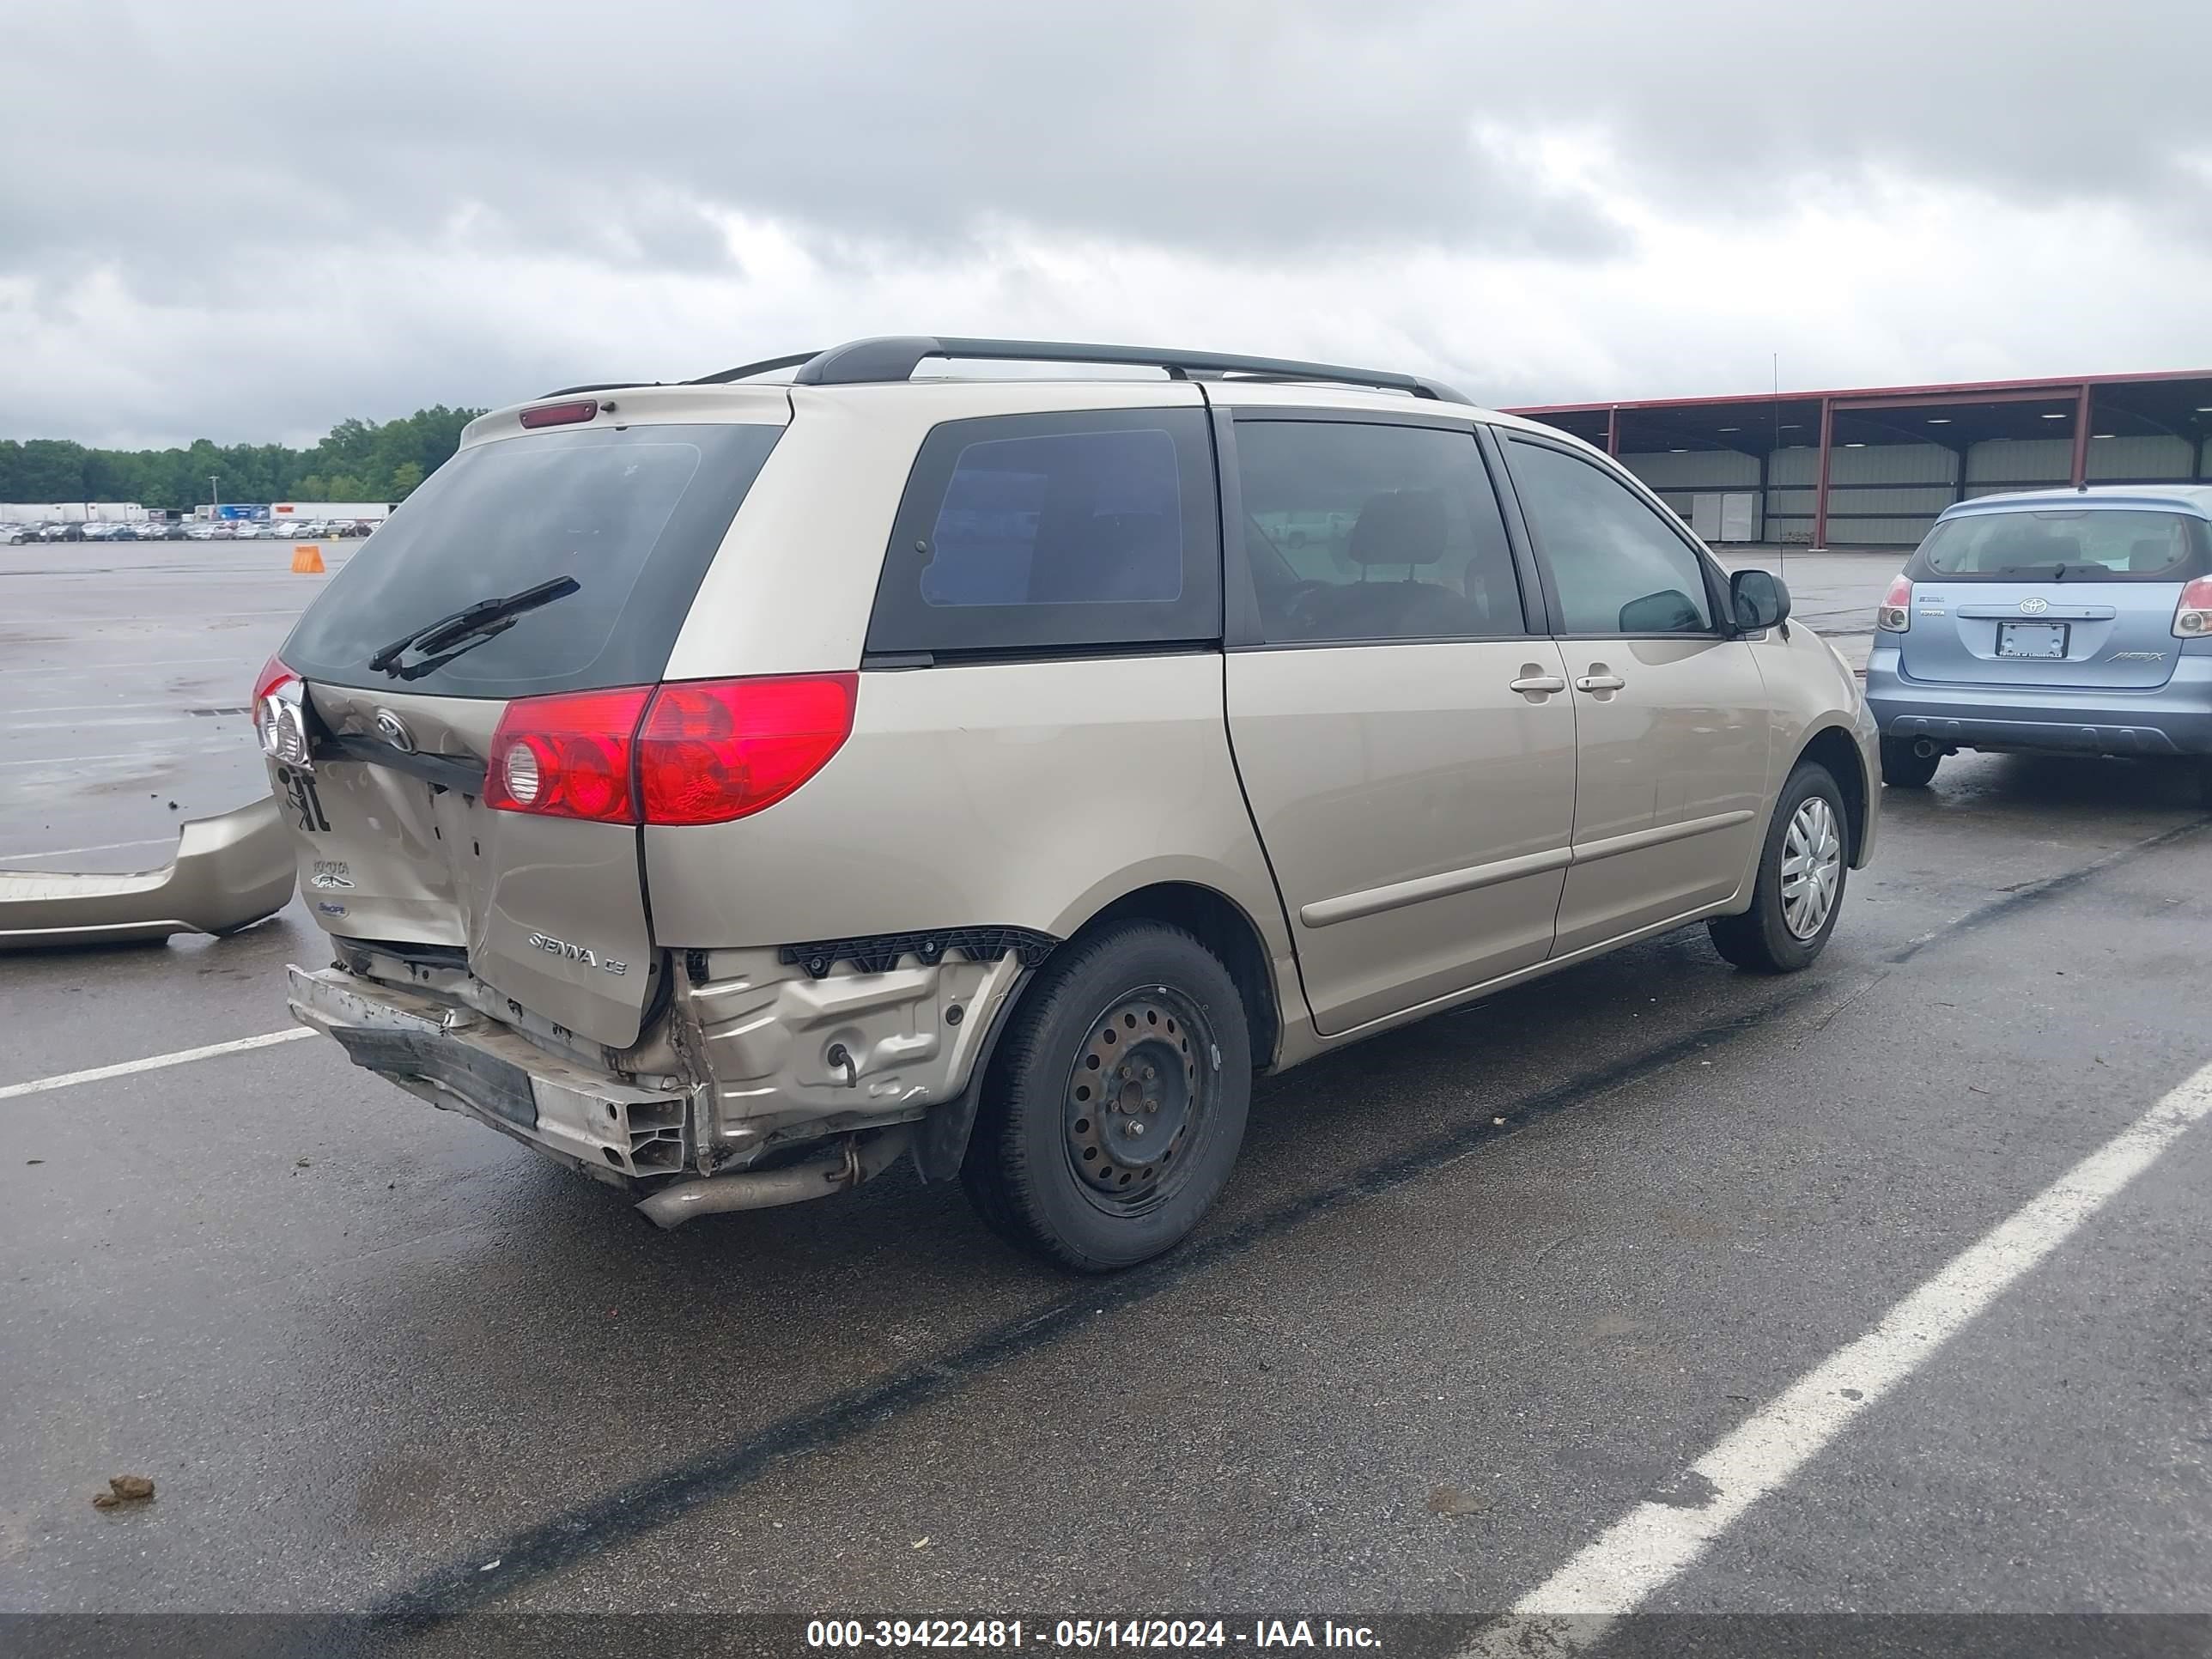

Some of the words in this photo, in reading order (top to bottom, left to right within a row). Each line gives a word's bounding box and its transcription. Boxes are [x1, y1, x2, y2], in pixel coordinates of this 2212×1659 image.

[2105, 652, 2167, 663] MATRIX
[313, 860, 349, 875] TOYOTA
[529, 932, 598, 968] SIENNA
[605, 958, 628, 976] CE
